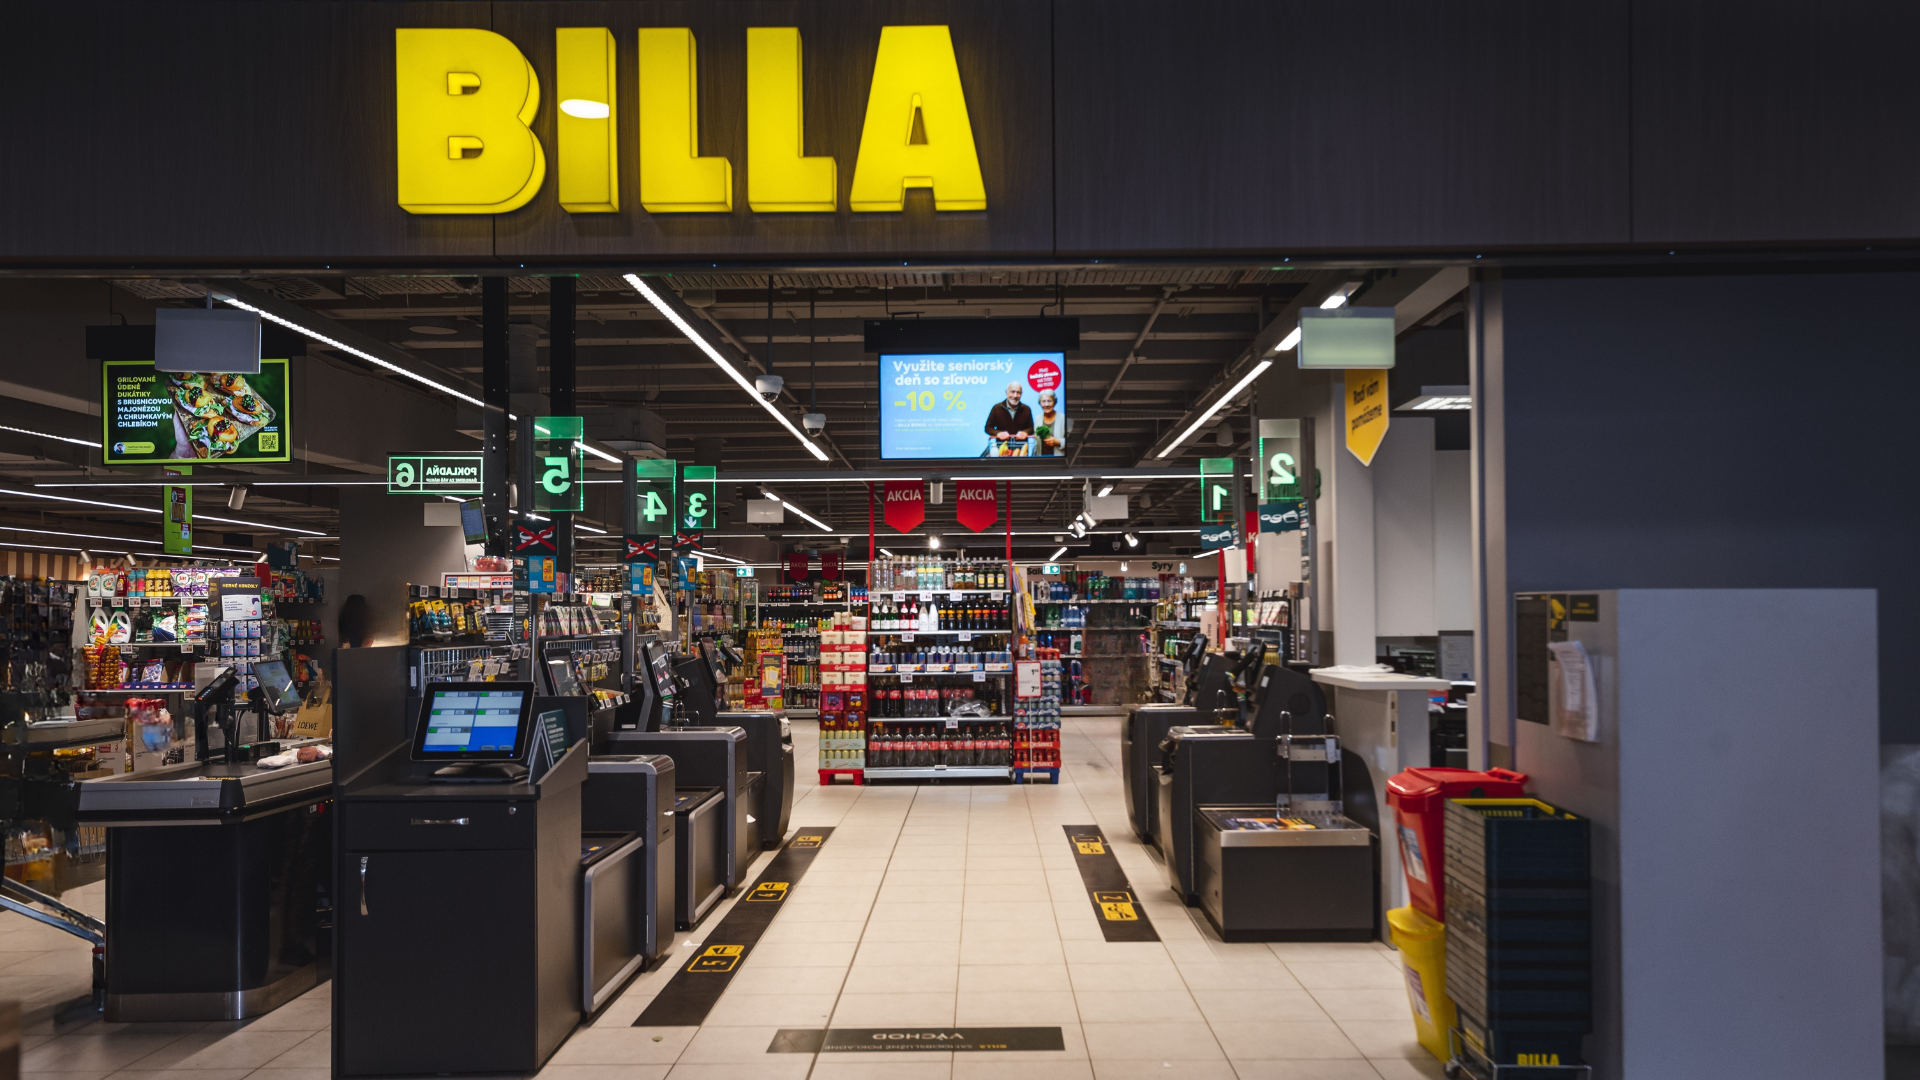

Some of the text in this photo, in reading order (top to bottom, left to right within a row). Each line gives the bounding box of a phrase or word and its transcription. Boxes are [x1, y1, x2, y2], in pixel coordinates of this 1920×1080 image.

[396, 25, 987, 214] BILLA
[893, 358, 1013, 375] Využite seniorský
[117, 375, 156, 383] GRILOVANÉ
[895, 373, 988, 386] deň so zľavou
[117, 390, 151, 398] DUKÁTIKY
[943, 390, 966, 411] %
[117, 405, 161, 413] MAJONÉZOU
[123, 412, 173, 420] CHRUMKAVÝM
[117, 420, 158, 428] CHLEBÍKOM
[887, 489, 921, 501] AKCIA
[959, 489, 994, 500] AKCIA
[1152, 561, 1173, 571] Syry
[297, 721, 318, 731] LOEWE
[872, 1032, 964, 1041] VÝCHOD
[1517, 1053, 1559, 1066] BILLA
